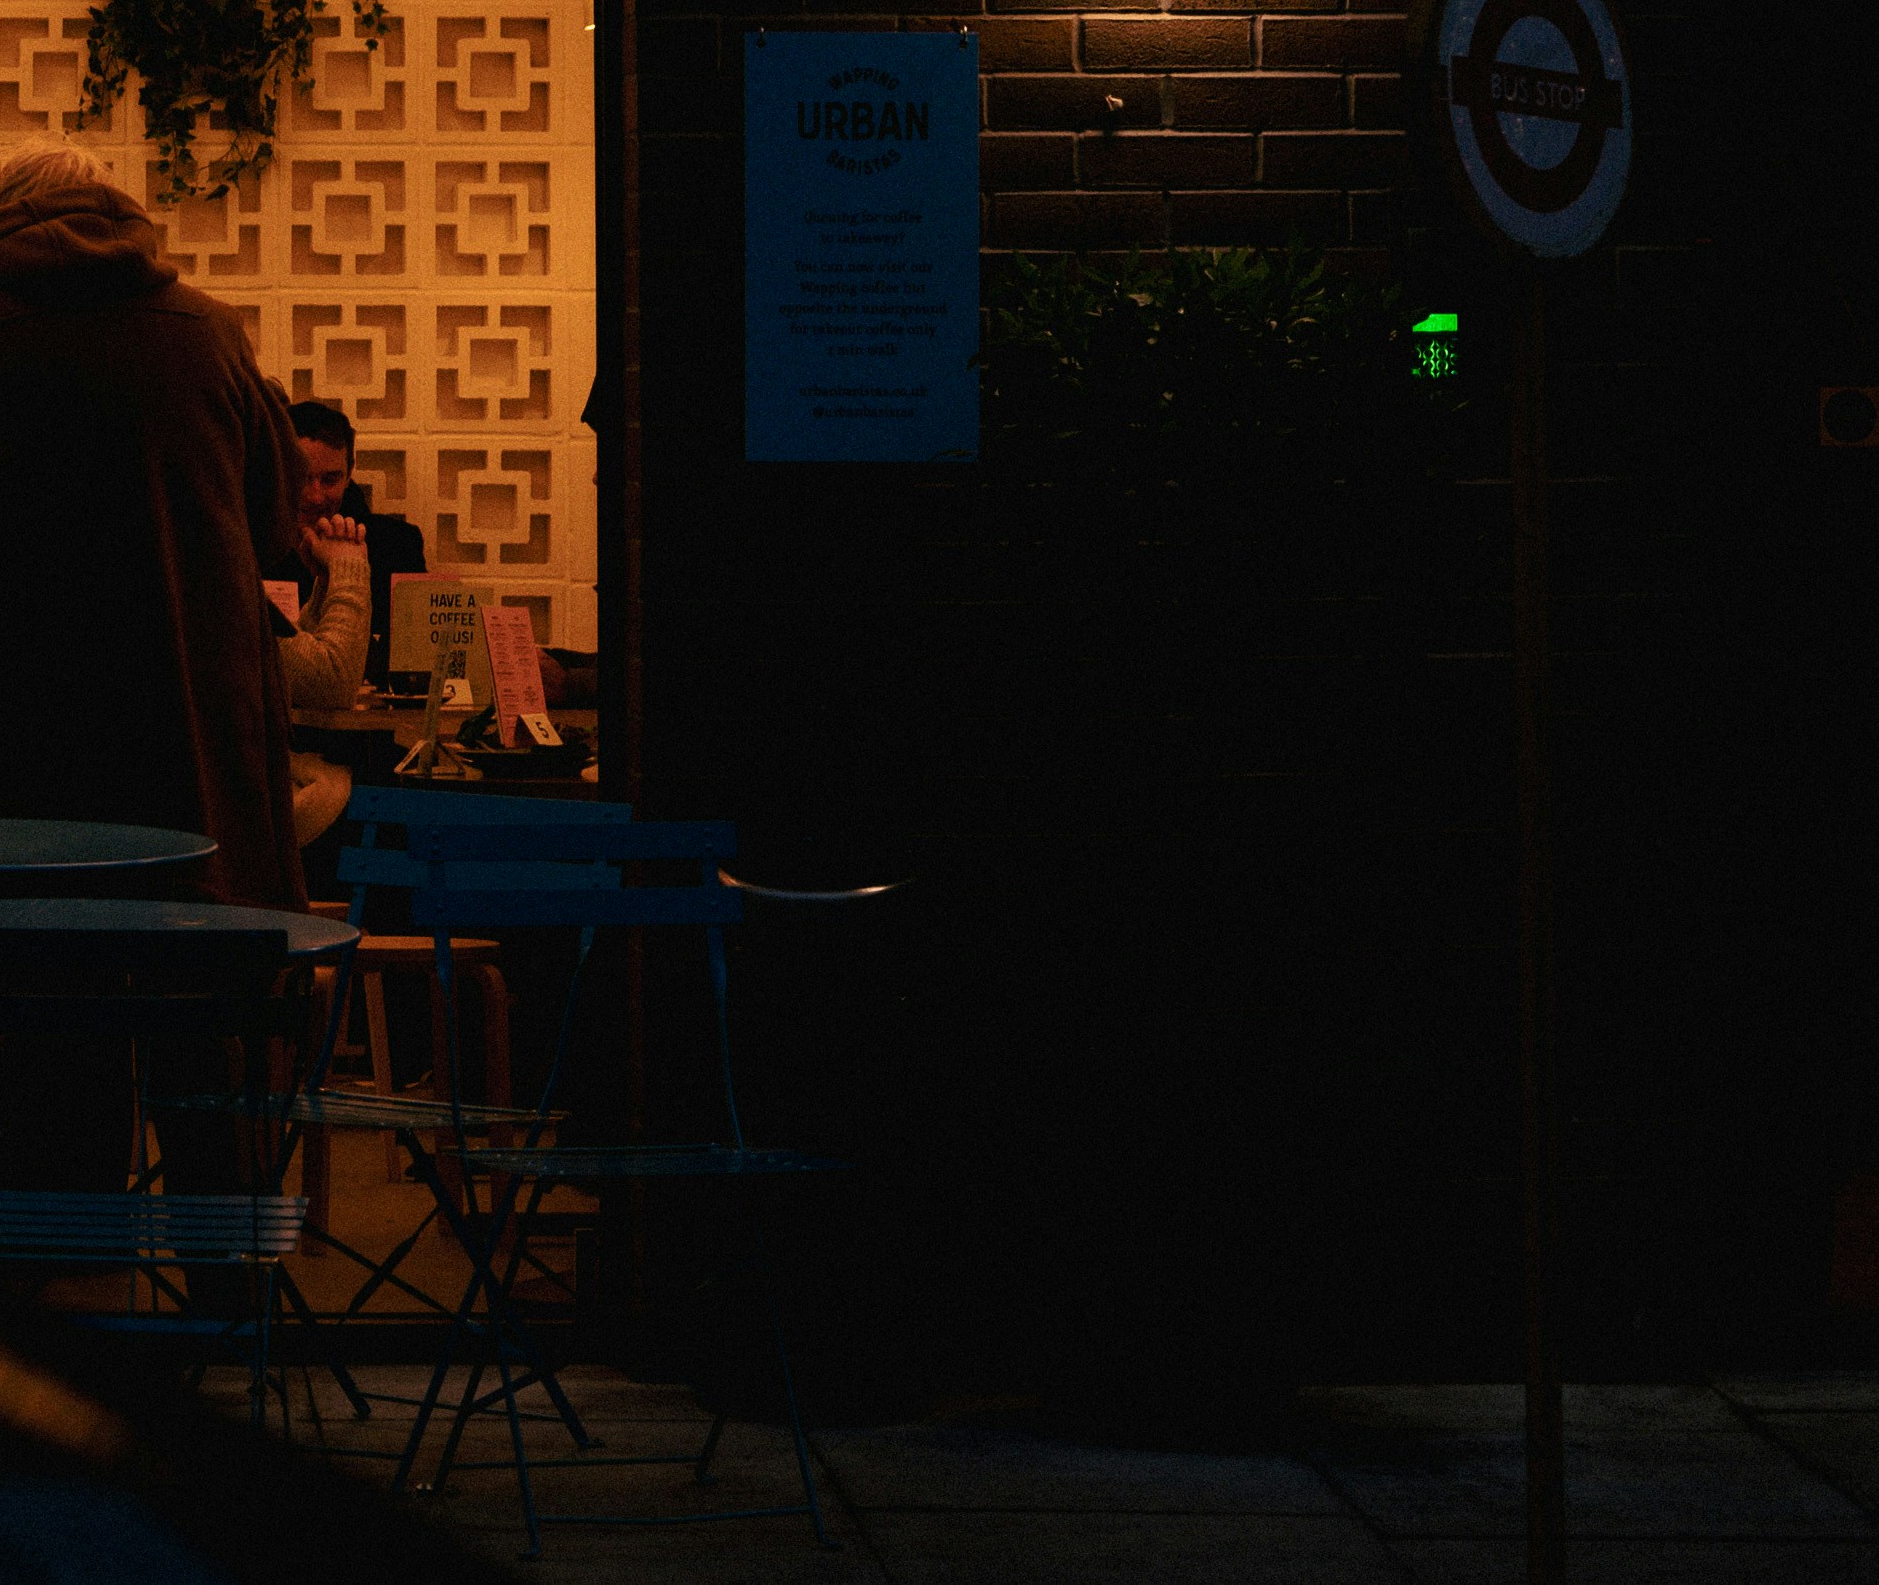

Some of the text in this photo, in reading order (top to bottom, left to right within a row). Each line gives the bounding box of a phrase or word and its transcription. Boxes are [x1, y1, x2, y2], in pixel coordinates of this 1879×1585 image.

[828, 66, 901, 92] WAPPING
[1490, 72, 1587, 111] BUS STOP
[796, 100, 930, 141] URBAN
[826, 147, 902, 177] BARISTAS
[429, 593, 477, 609] HAVE A
[429, 611, 476, 627] COFFEE
[452, 630, 475, 645] US!
[535, 720, 551, 740] 5
